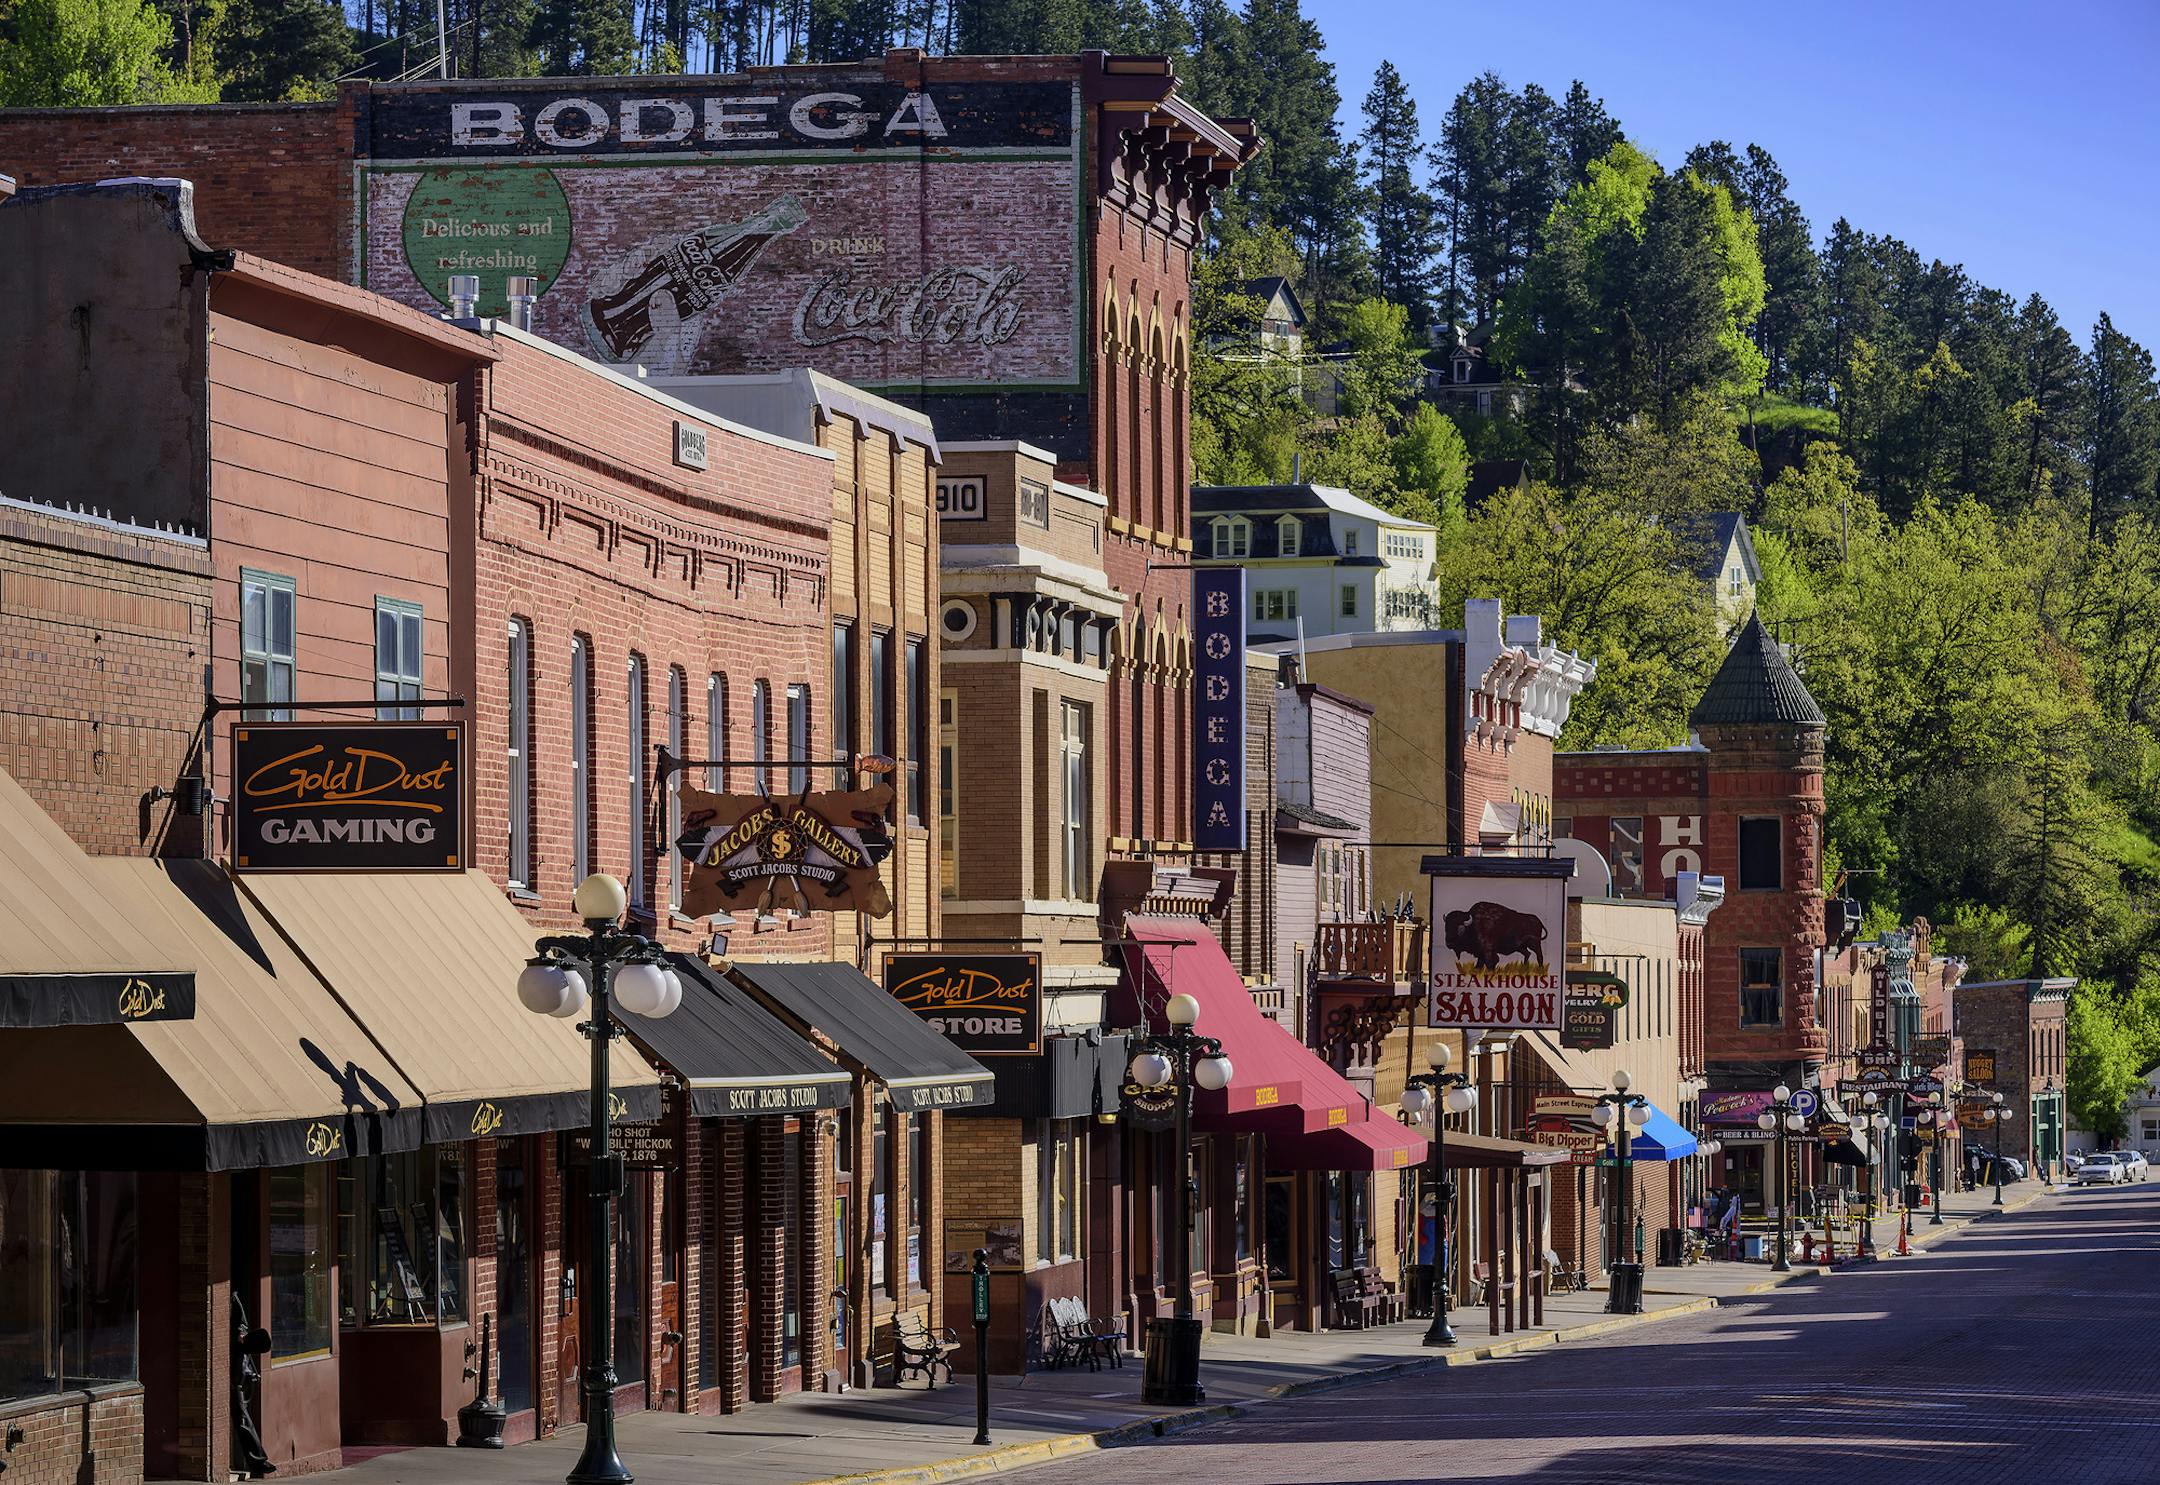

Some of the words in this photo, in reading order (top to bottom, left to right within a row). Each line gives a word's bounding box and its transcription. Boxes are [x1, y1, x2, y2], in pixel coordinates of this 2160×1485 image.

[452, 91, 949, 149] BODEGA
[422, 218, 510, 238] Delicious
[518, 216, 552, 236] and
[811, 237, 887, 255] DRINK
[438, 249, 538, 273] refreshing
[793, 264, 1029, 350] Coca-Cola
[1205, 591, 1231, 828] BODEGA
[244, 744, 353, 799] Gold
[323, 746, 454, 800] Dust
[260, 818, 436, 845] GAMING
[707, 807, 774, 867] JACOBS
[794, 809, 863, 867] GALLERY
[728, 866, 758, 881] SCOTT
[761, 863, 798, 875] JACOBS
[801, 865, 836, 882] STUDIO
[891, 966, 965, 1004] Gold
[945, 968, 1034, 1005] Dust
[1434, 973, 1559, 989] STEAKHOUSE
[1436, 991, 1556, 1024] SALOON
[927, 1017, 1023, 1035] STORE
[1569, 1015, 1605, 1024] GOLD
[1968, 1059, 1993, 1069] NUGGET
[1968, 1069, 1994, 1080] SALOON
[912, 1088, 932, 1107] SCOTT
[933, 1086, 953, 1105] JACOBS
[954, 1085, 974, 1103] STUDIO
[1255, 1087, 1279, 1106] BODEGA
[1841, 1081, 1909, 1092] RESTAURANT
[729, 1090, 756, 1110] SCOTT
[759, 1088, 788, 1108] JACOBS
[791, 1087, 818, 1106] STUDIO
[1133, 1098, 1175, 1112] SHOPPE
[1702, 1094, 1754, 1117] Peacock's
[1328, 1106, 1347, 1127] BODEGA
[608, 1127, 621, 1138] HO
[624, 1127, 651, 1138] SHOT
[1538, 1132, 1555, 1147] Big
[1557, 1134, 1593, 1150] Dipper
[1722, 1130, 1742, 1139] BEER
[1743, 1130, 1750, 1139] &
[1751, 1130, 1775, 1139] BLING
[609, 1138, 633, 1149] BILL"
[634, 1138, 672, 1150] HICKOK
[632, 1150, 657, 1161] 1876
[1790, 1151, 1799, 1197] HOTEL
